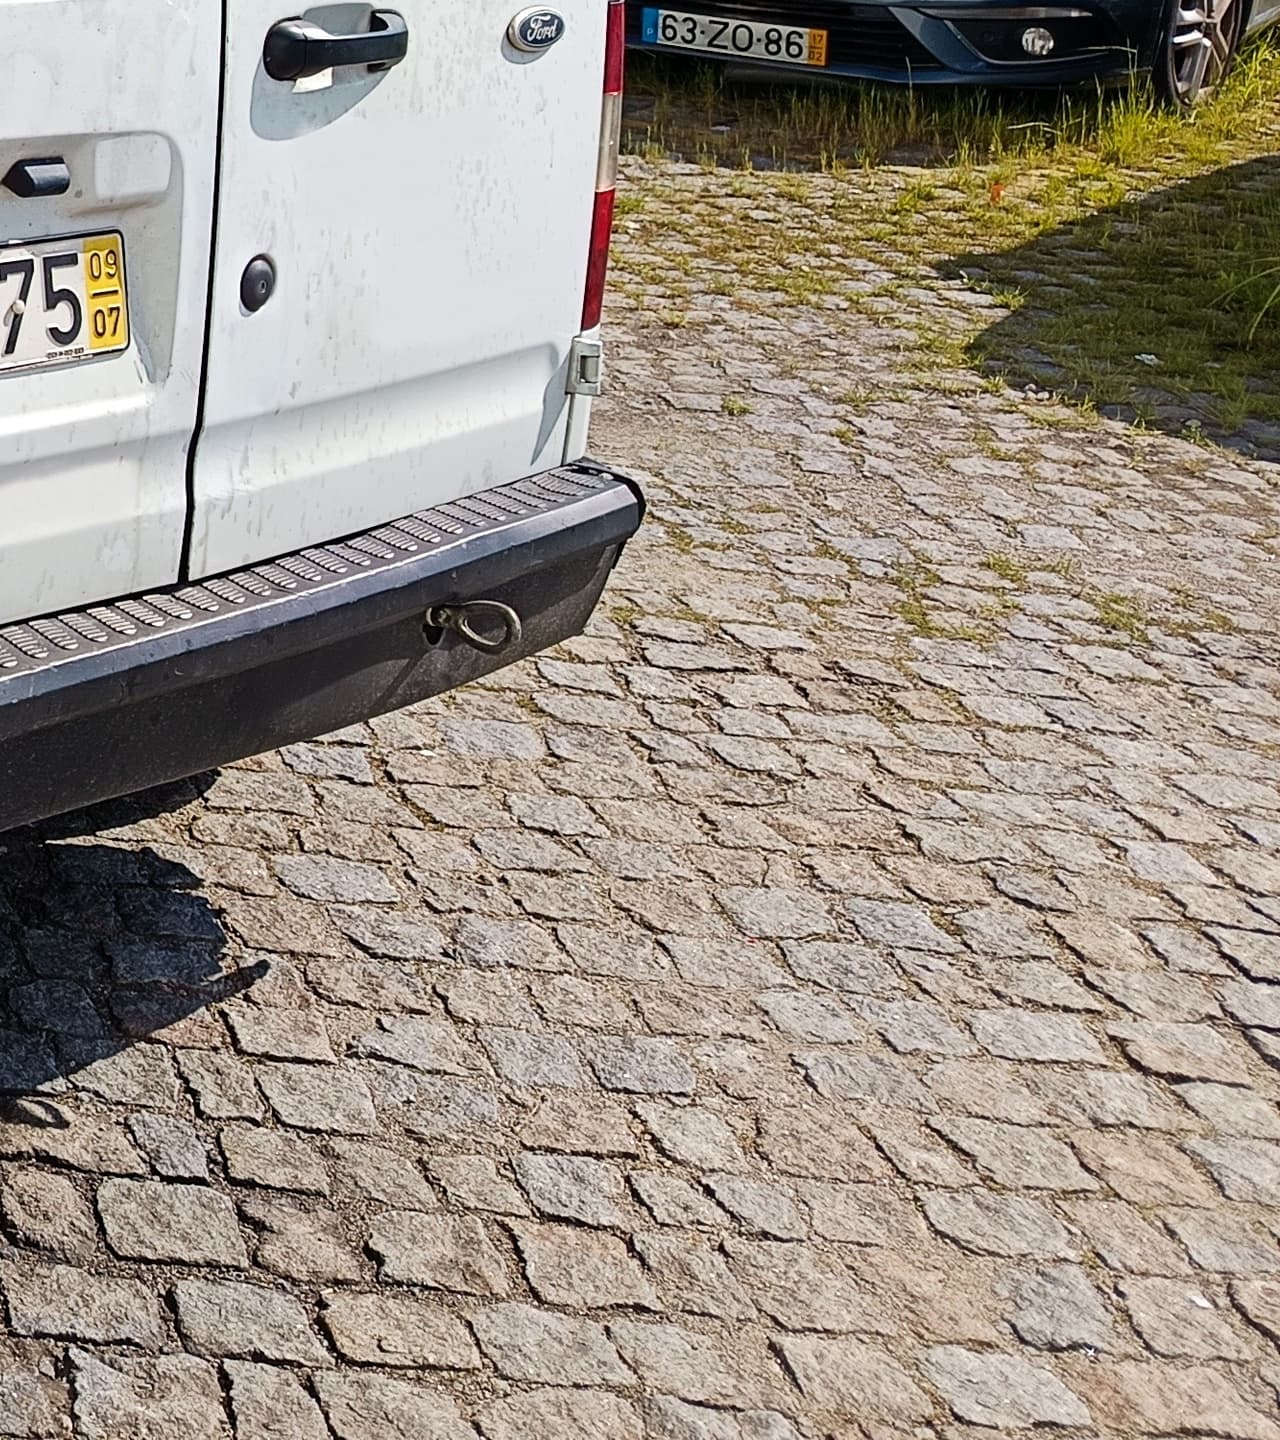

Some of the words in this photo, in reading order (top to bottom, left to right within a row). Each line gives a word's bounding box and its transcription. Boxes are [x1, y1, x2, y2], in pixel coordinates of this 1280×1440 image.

[526, 14, 559, 42] Ford
[89, 248, 118, 280] 09
[93, 305, 121, 338] 07
